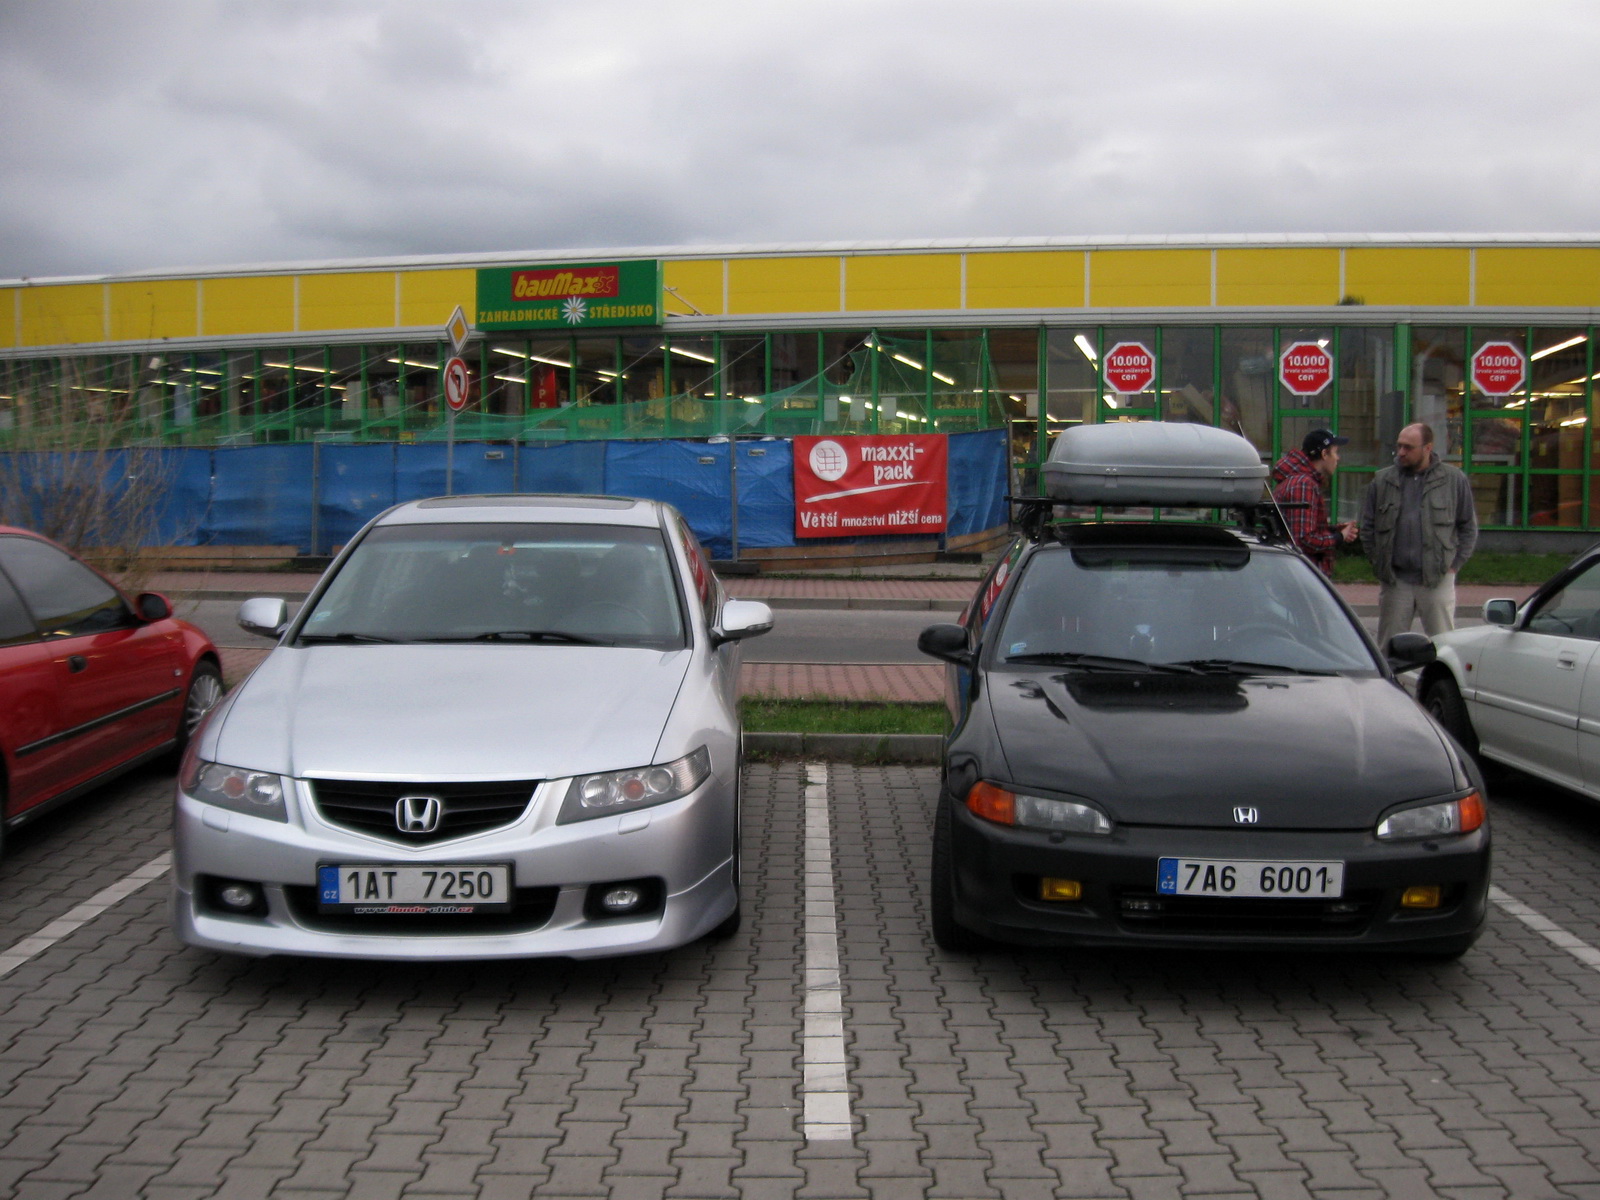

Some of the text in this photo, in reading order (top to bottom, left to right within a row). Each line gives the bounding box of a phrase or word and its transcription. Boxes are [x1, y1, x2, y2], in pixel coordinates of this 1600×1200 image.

[479, 304, 653, 323] ZAHRADNICKÉ STŘEDISKO
[1111, 356, 1148, 366] 10.000
[1288, 355, 1325, 367] 10.000
[1479, 356, 1517, 367] 10.000
[861, 442, 924, 462] maxxi-
[873, 461, 914, 485] pack
[800, 509, 942, 529] Větší množství nižší cena
[347, 871, 493, 900] 1AT 7250
[1161, 881, 1175, 890] CZ
[1184, 864, 1328, 894] 7A6 6001
[323, 891, 337, 900] CZ
